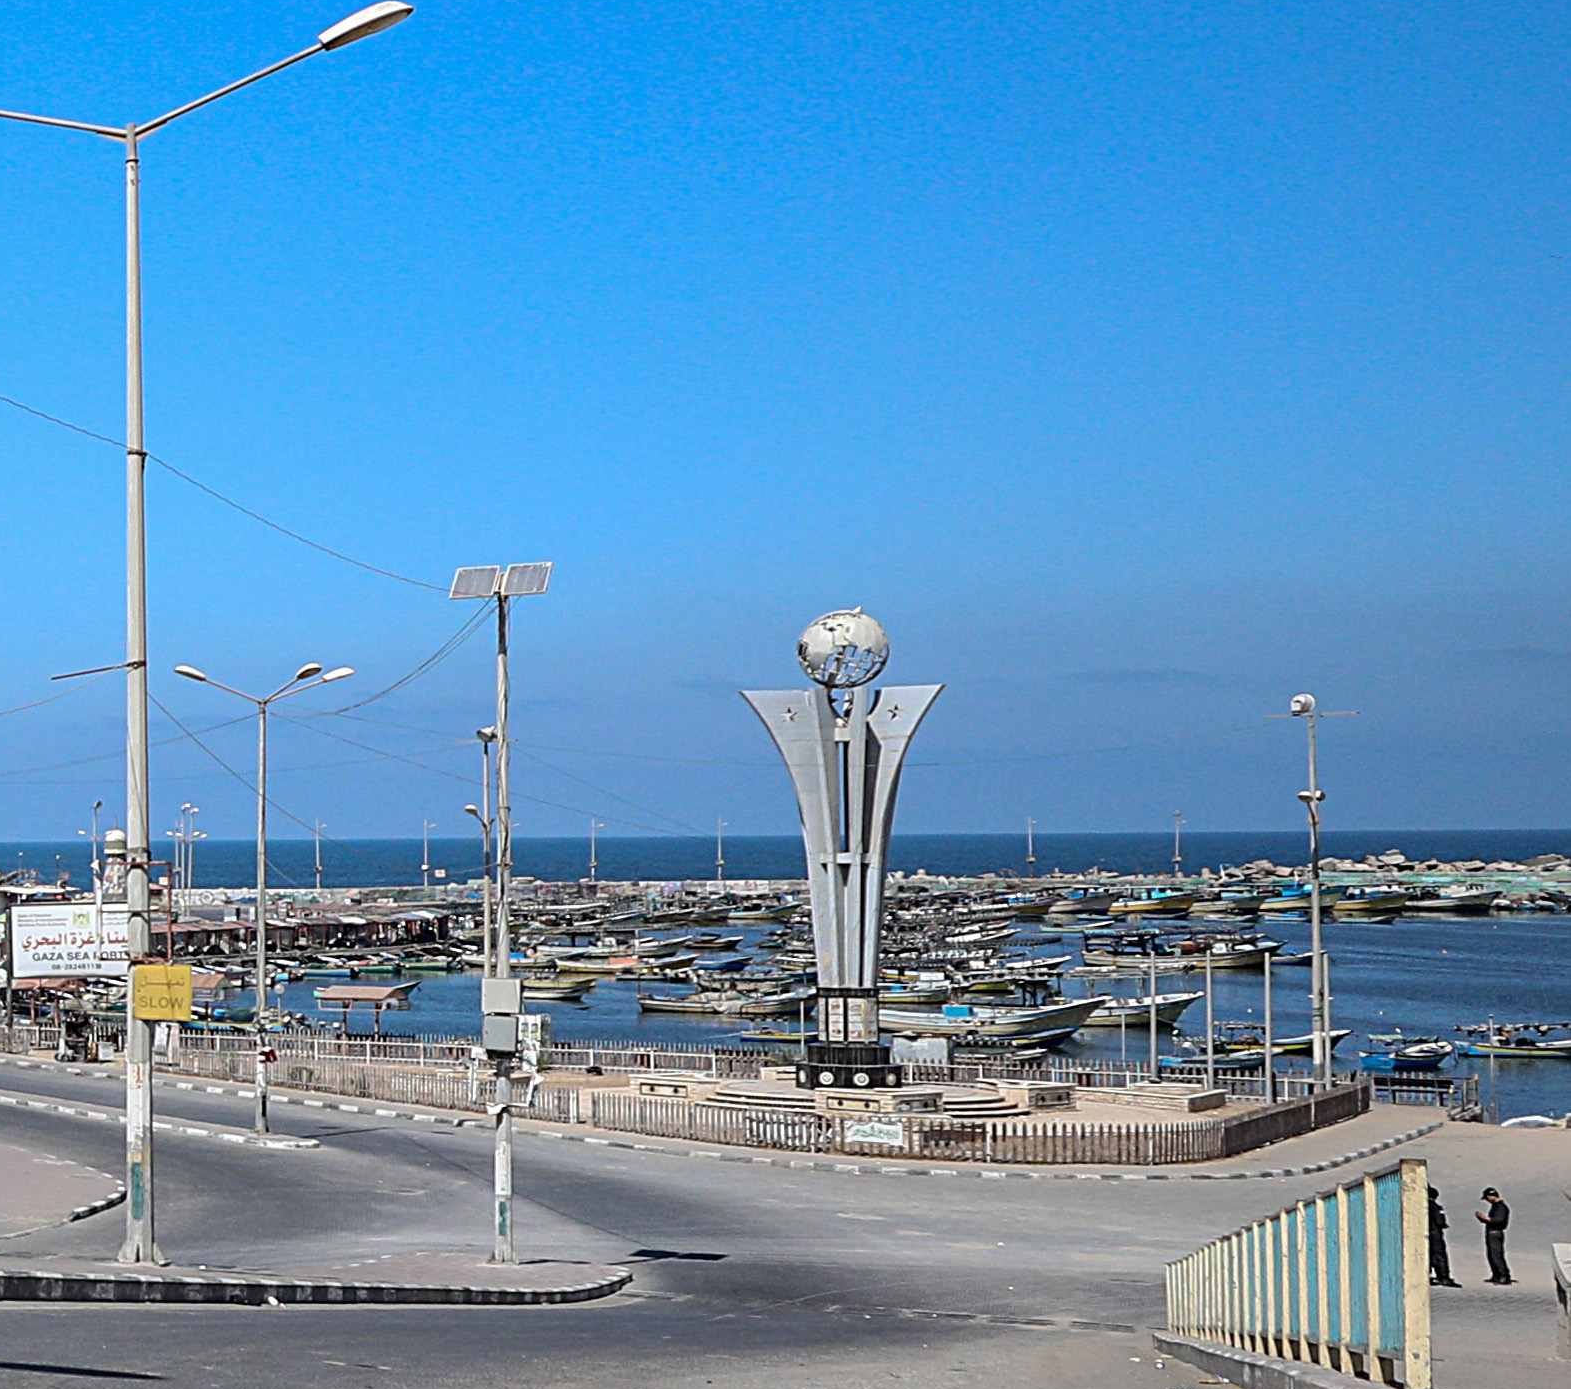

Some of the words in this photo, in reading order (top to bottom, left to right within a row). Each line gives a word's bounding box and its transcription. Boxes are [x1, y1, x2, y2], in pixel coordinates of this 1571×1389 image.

[21, 933, 68, 951] البحري
[70, 932, 95, 948] غزة
[99, 931, 128, 948] يناء
[32, 952, 64, 961] GAZA
[66, 952, 91, 961] SEA
[139, 996, 184, 1009] SLOW
